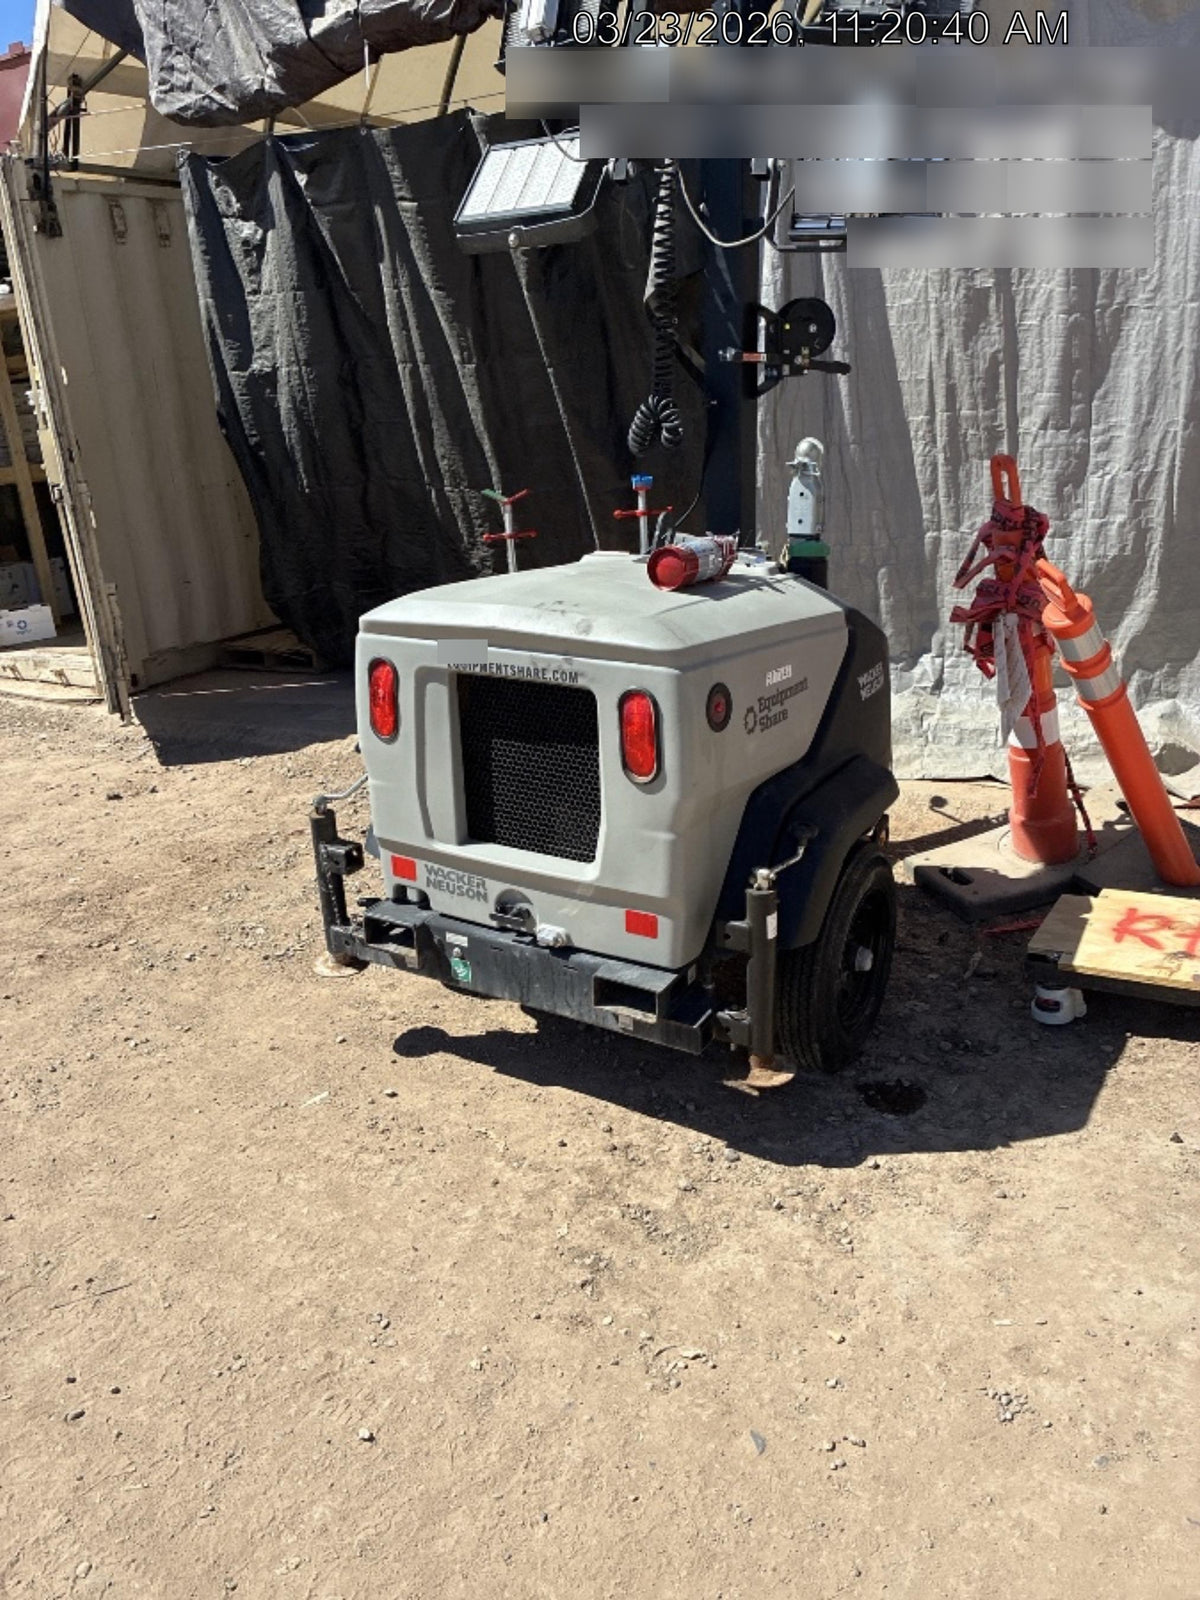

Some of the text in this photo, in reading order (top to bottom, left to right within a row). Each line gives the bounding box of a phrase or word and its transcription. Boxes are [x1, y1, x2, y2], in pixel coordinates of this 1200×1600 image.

[757, 677, 809, 713] Equipment
[758, 708, 789, 732] Share
[424, 863, 488, 892] WACKER
[426, 876, 489, 904] NEUSON
